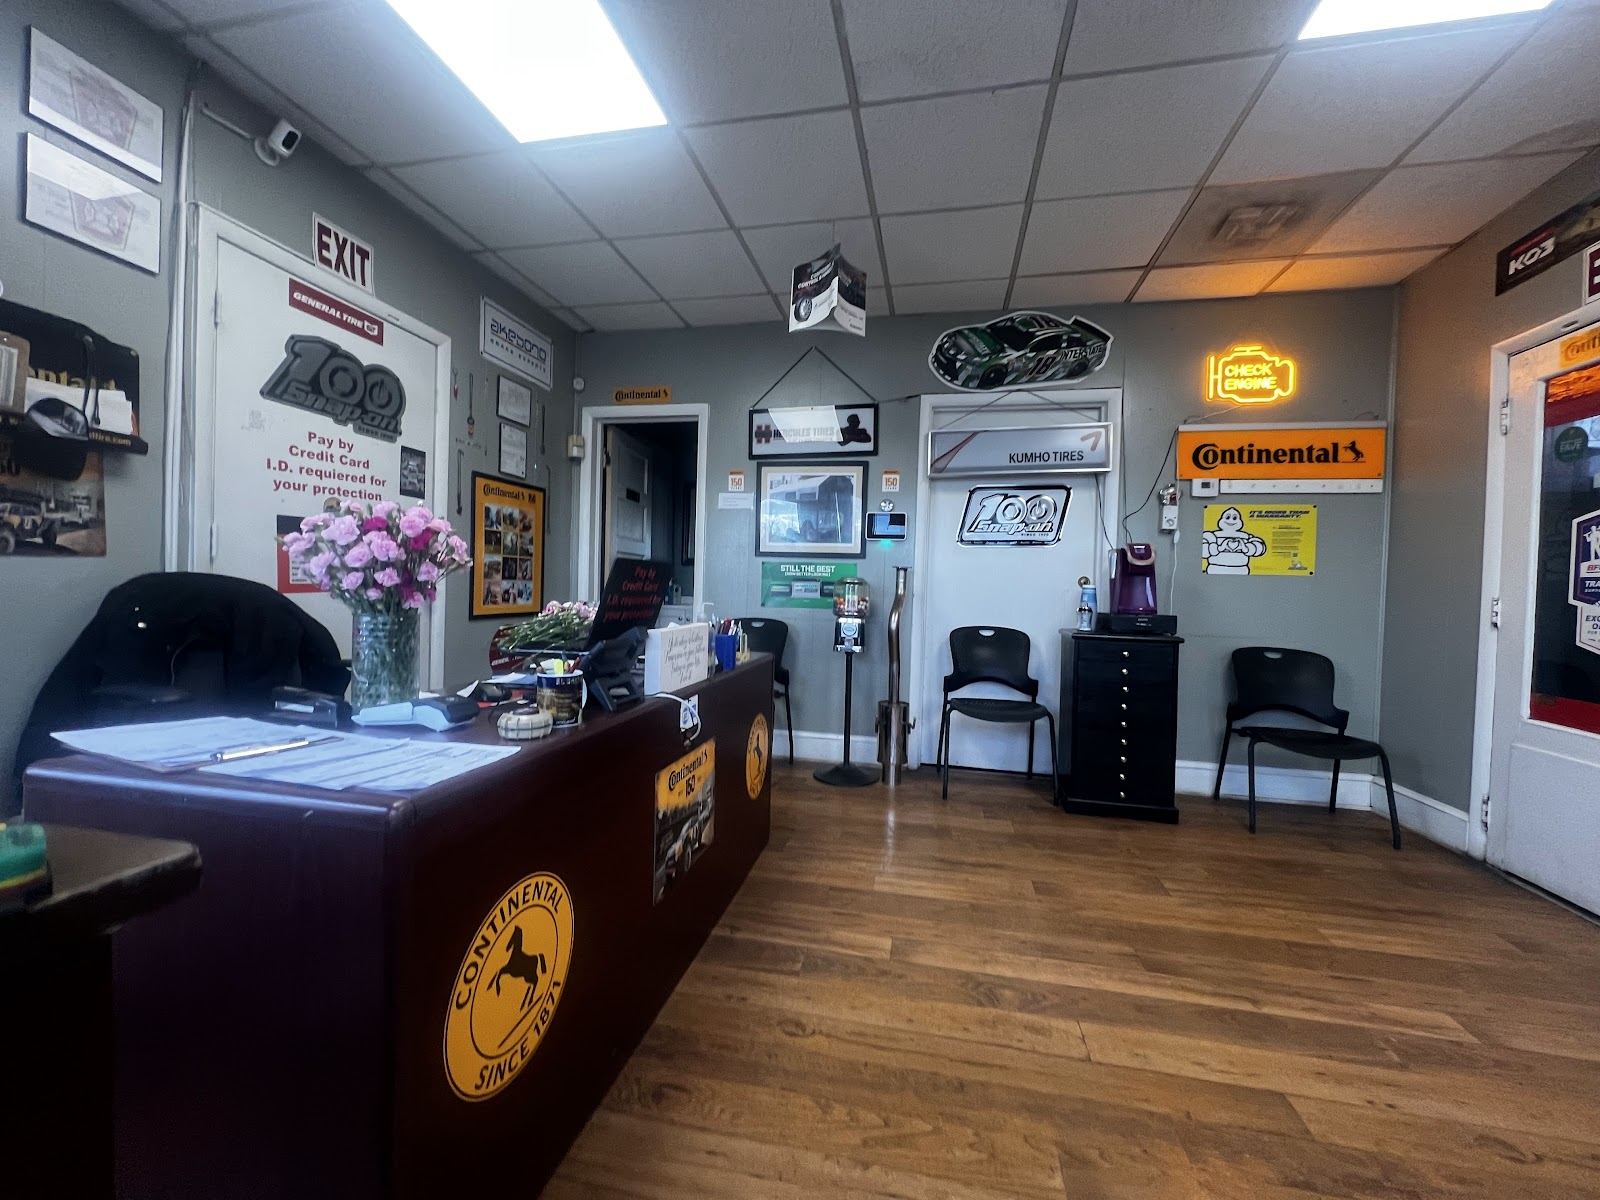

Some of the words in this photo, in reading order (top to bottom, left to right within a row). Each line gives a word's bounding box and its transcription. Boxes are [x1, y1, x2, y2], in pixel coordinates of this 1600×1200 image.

[317, 222, 370, 287] EXIT
[293, 291, 342, 319] GENERAL
[342, 312, 364, 329] TIRE
[490, 318, 547, 364] akebono
[1029, 355, 1057, 376] 18
[1224, 363, 1273, 376] CHECK
[1224, 377, 1278, 391] ENGINE
[614, 389, 661, 402] Continental
[307, 431, 334, 449] Pay
[338, 438, 354, 453] by
[773, 427, 812, 439] HERCULES
[813, 426, 835, 438] TIRES
[288, 445, 335, 464] Credit
[339, 454, 370, 470] Card
[1008, 451, 1051, 464] KUMHO
[1053, 450, 1084, 462] TIRES
[1191, 442, 1340, 471] Continental
[266, 458, 293, 473] I.D.
[299, 466, 366, 484] requiered
[370, 475, 387, 488] for
[730, 477, 743, 487] 150
[884, 477, 898, 487] 150
[273, 479, 308, 492] your
[312, 484, 382, 501] protection
[482, 483, 520, 501] Continental
[780, 564, 800, 572] STILL
[800, 565, 815, 573] THE
[816, 565, 836, 573] BEST
[668, 757, 705, 791] Continental
[455, 880, 564, 1010] CONTINENTAL
[474, 1036, 530, 1092] SINCE
[533, 980, 562, 1036] 1871
